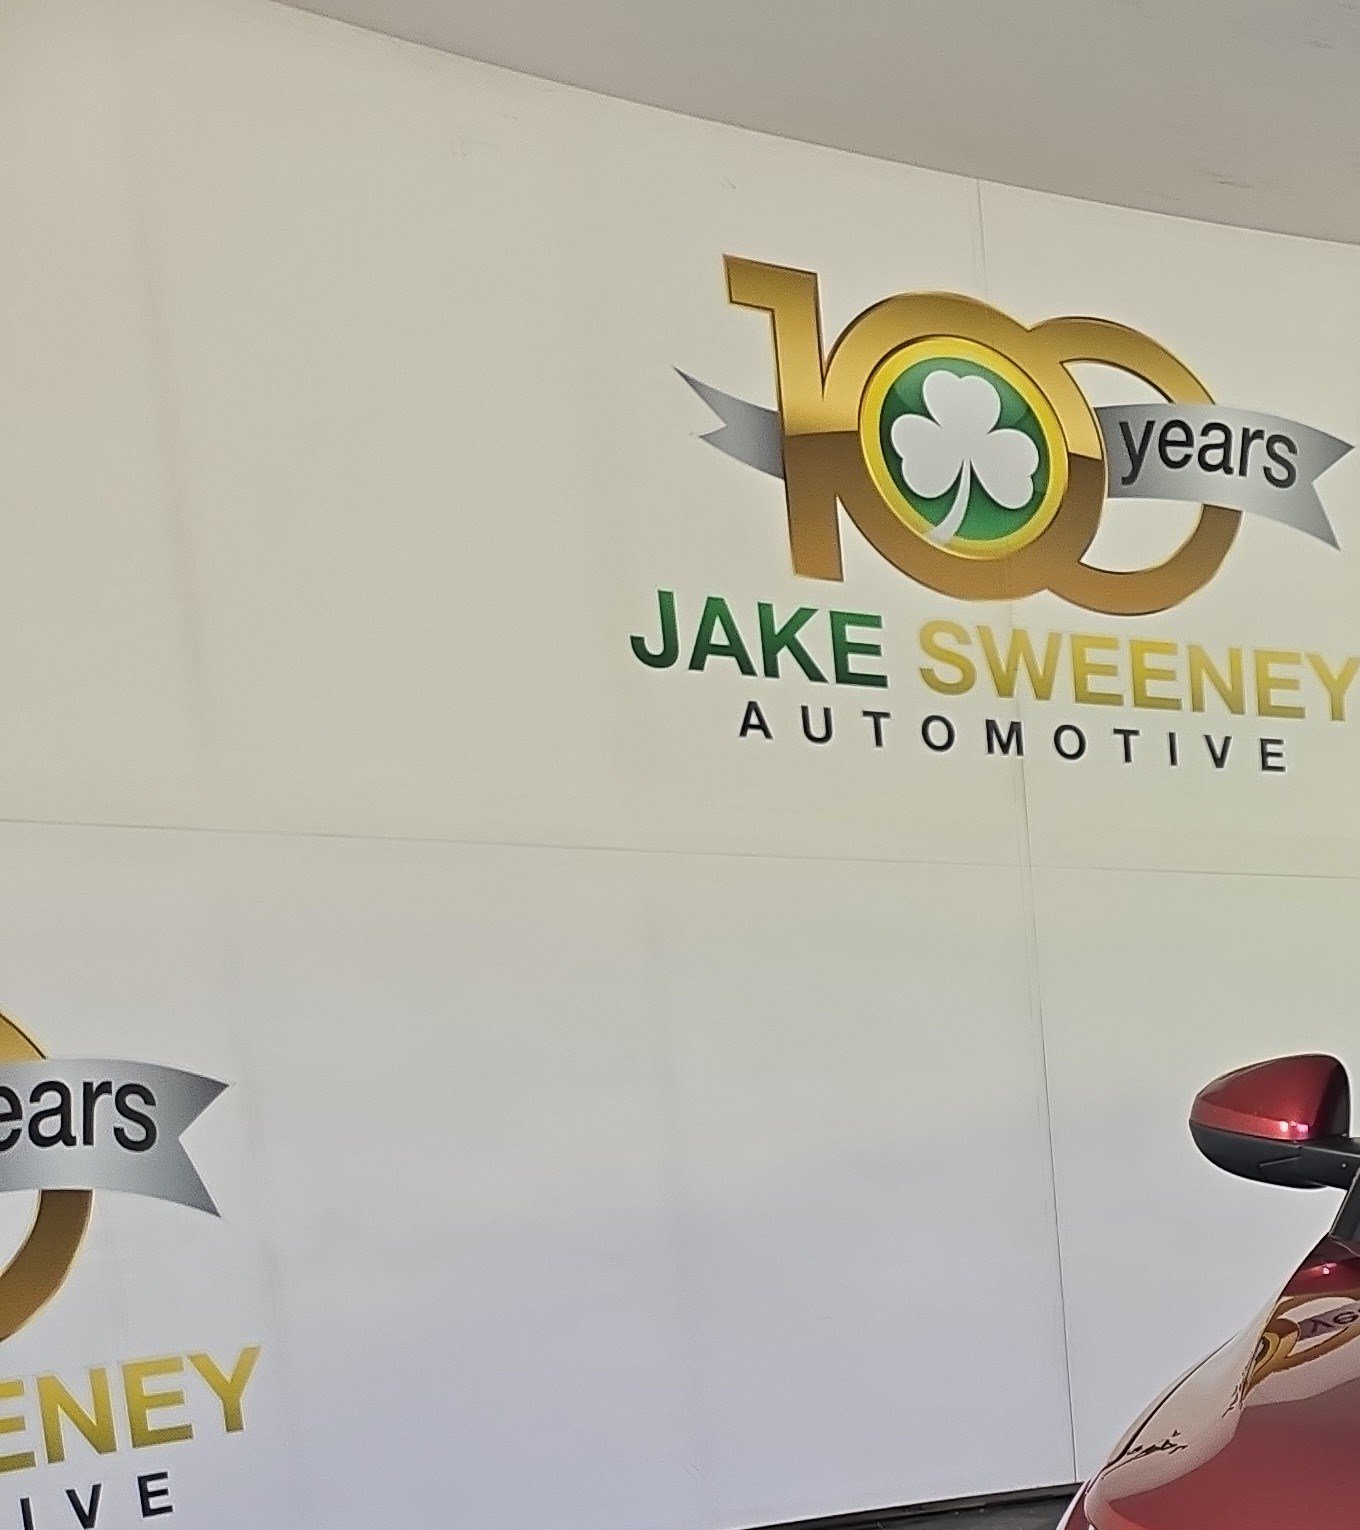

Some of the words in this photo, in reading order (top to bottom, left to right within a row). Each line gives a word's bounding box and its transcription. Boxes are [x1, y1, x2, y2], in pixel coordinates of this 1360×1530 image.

[1119, 418, 1298, 488] years
[629, 589, 889, 688] JAKE
[738, 700, 1287, 773] AUTOMOTIVE
